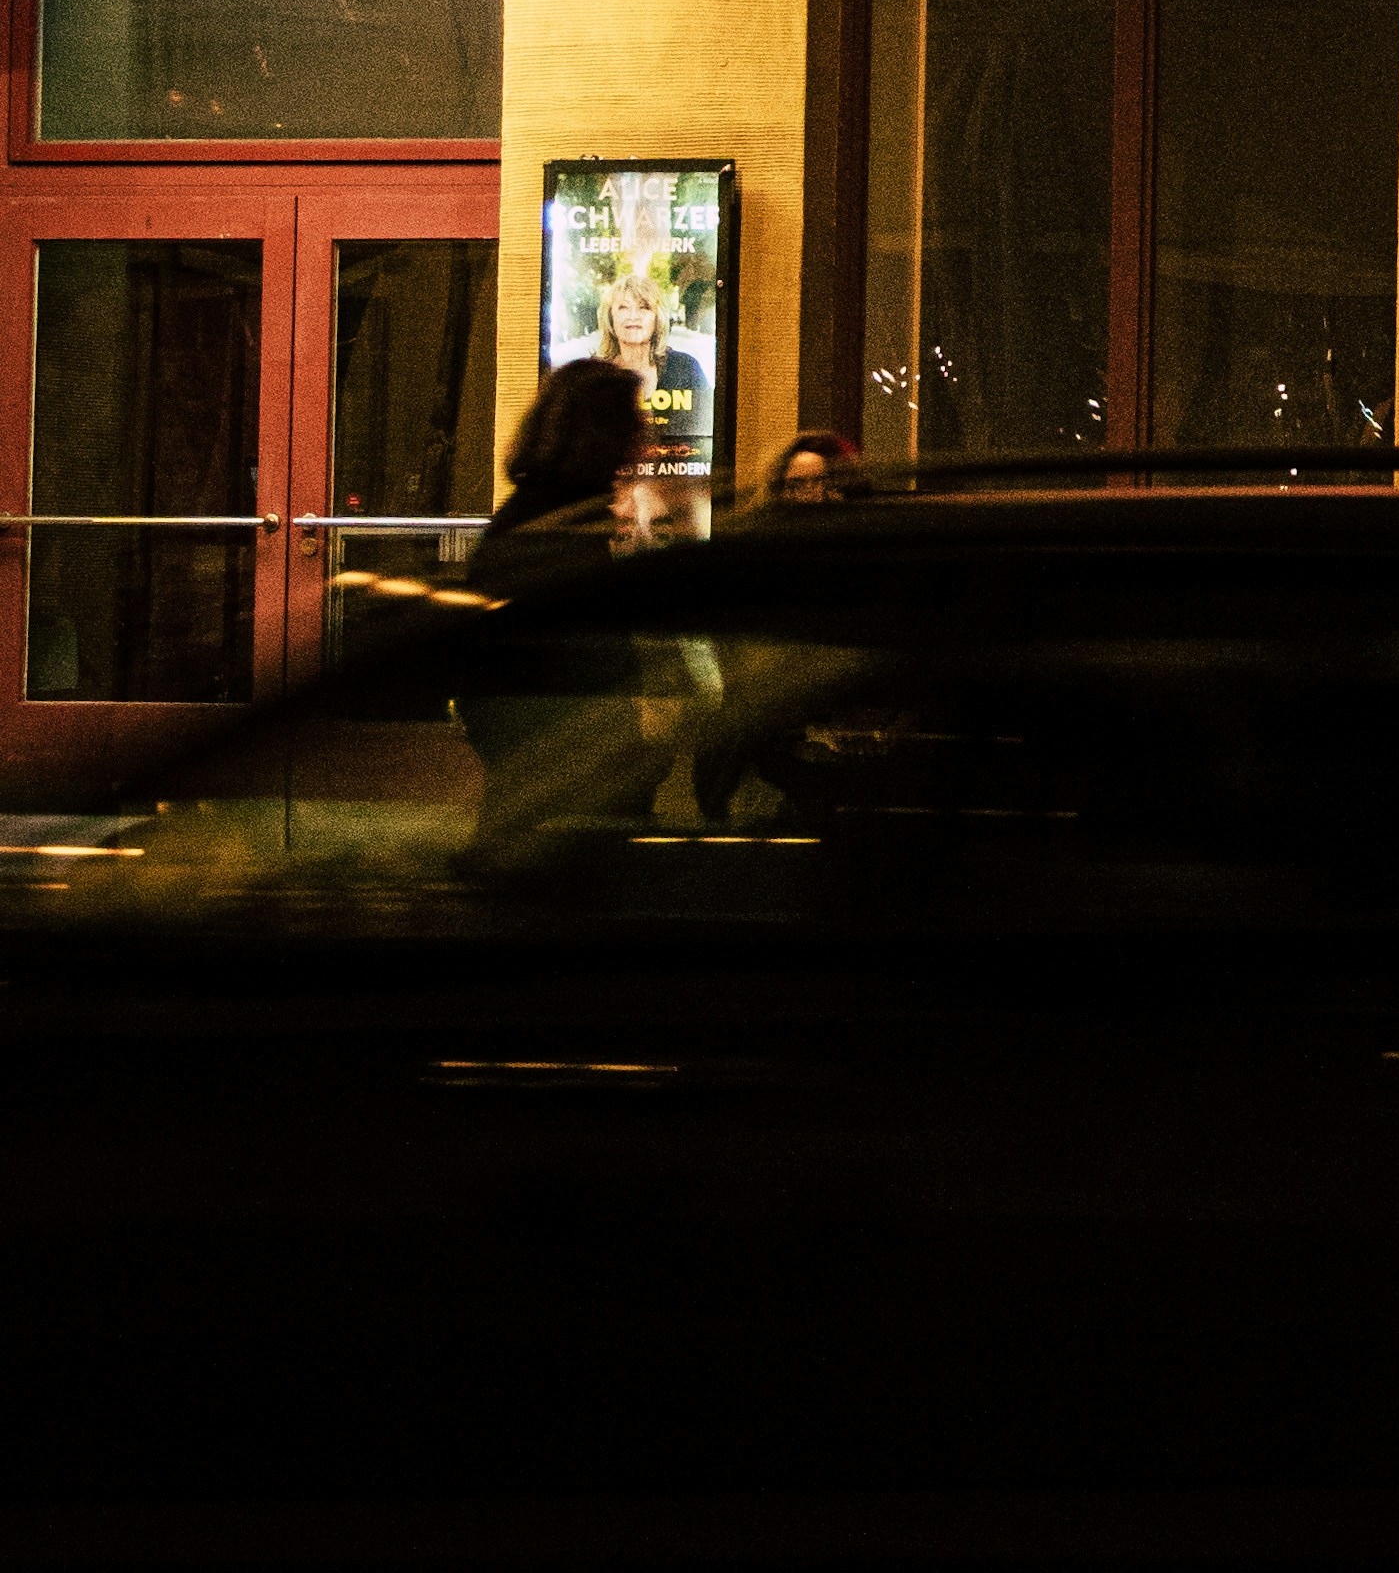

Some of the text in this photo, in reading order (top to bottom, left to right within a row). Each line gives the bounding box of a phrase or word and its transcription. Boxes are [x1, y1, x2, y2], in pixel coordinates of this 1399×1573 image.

[599, 178, 677, 201] ALICE
[637, 462, 655, 476] DIE
[658, 462, 712, 476] ANDERN
